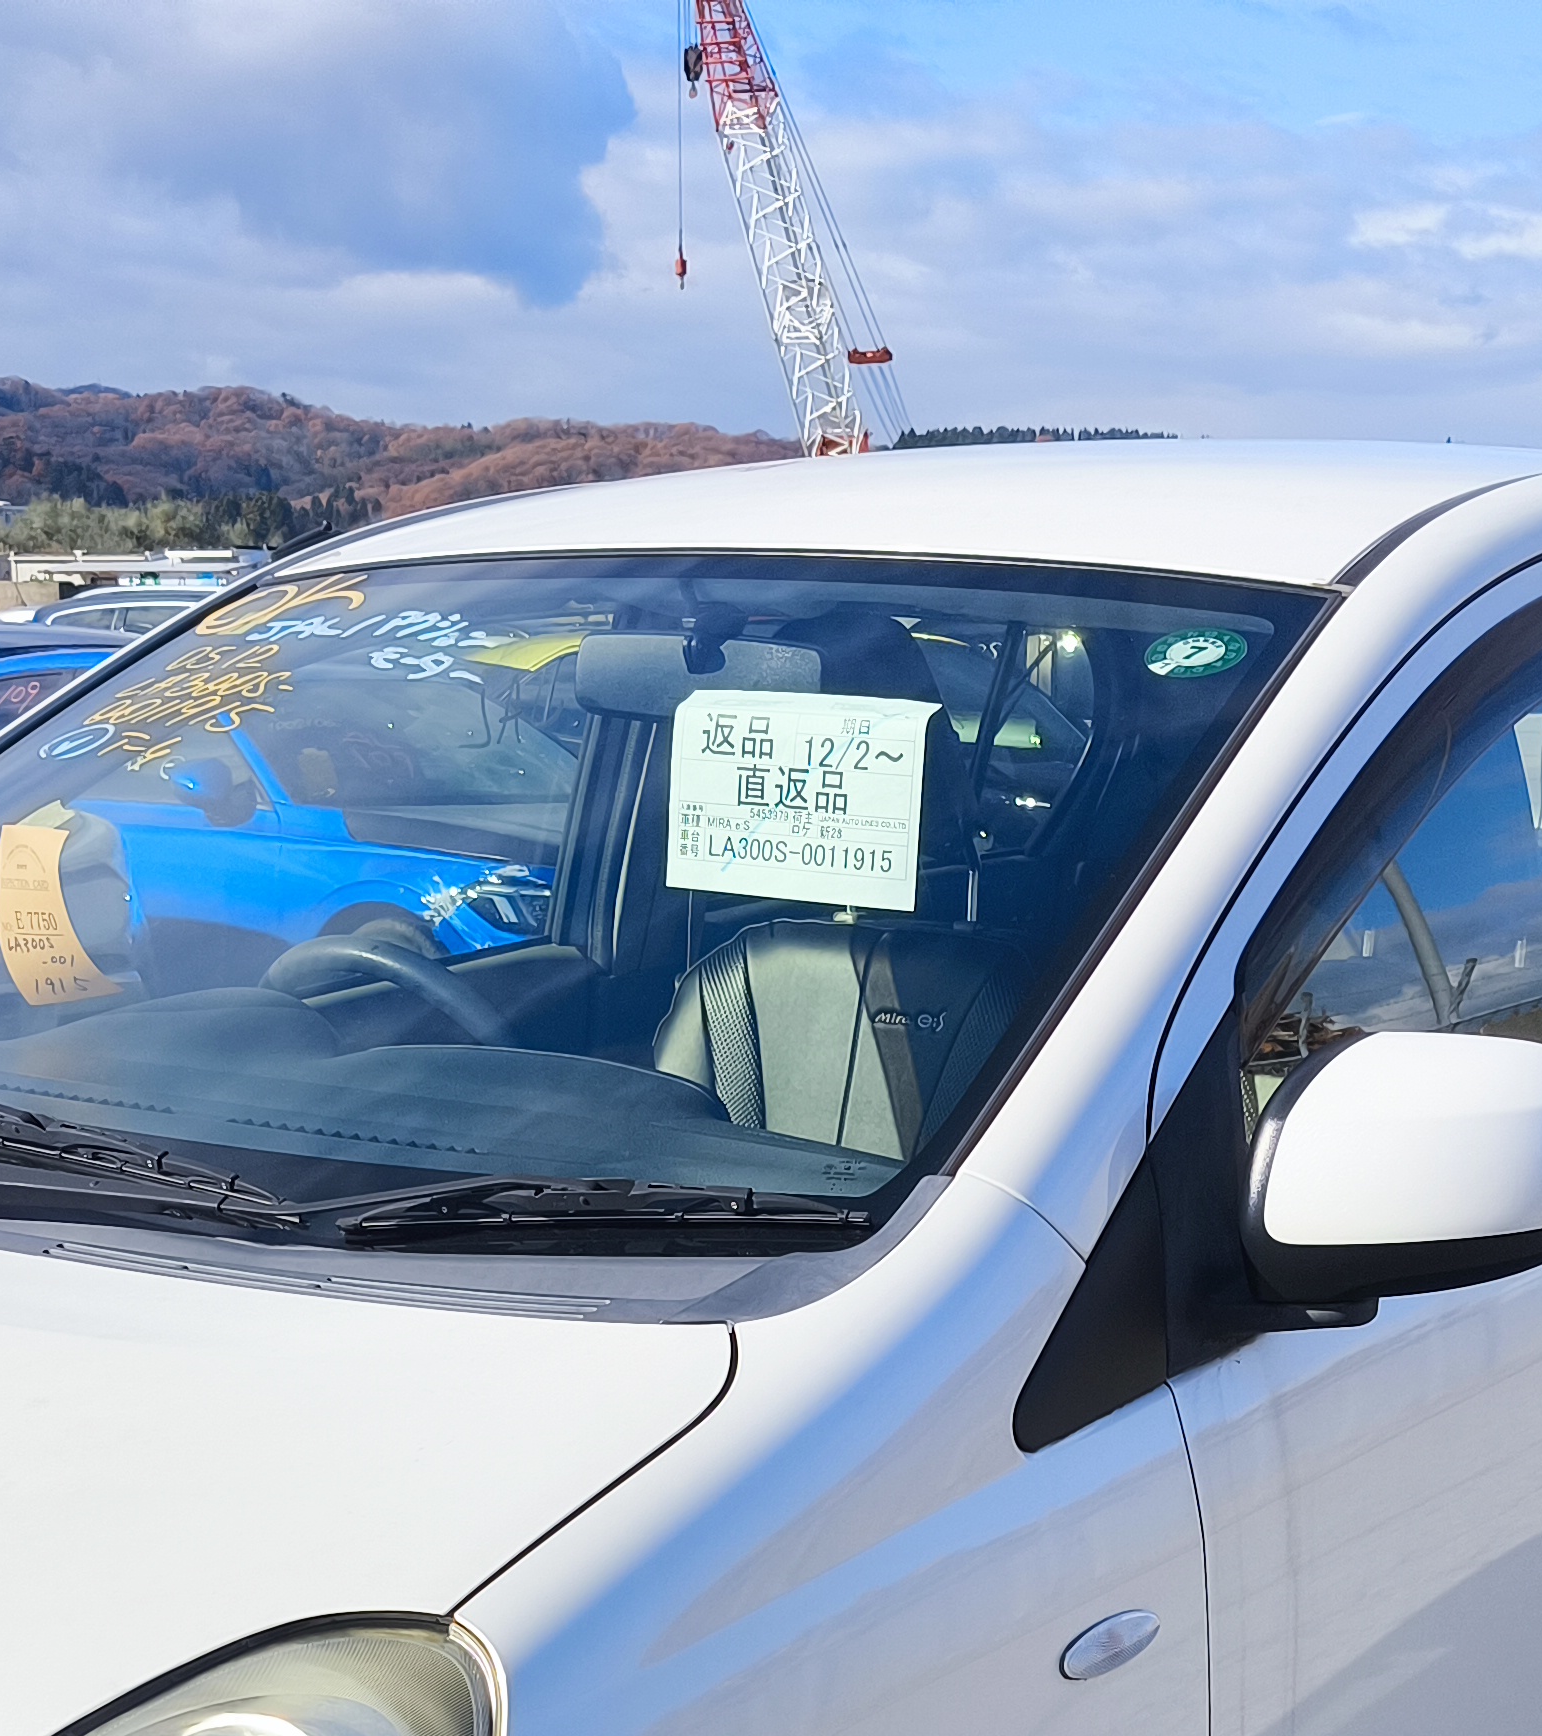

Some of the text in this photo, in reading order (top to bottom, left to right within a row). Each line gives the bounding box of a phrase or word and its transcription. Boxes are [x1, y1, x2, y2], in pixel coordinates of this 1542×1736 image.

[701, 713, 774, 760] 返品
[737, 764, 849, 815] 直返品
[707, 816, 732, 830] MIRA
[708, 834, 893, 874] LA300S-0011915
[27, 911, 58, 931] 7750
